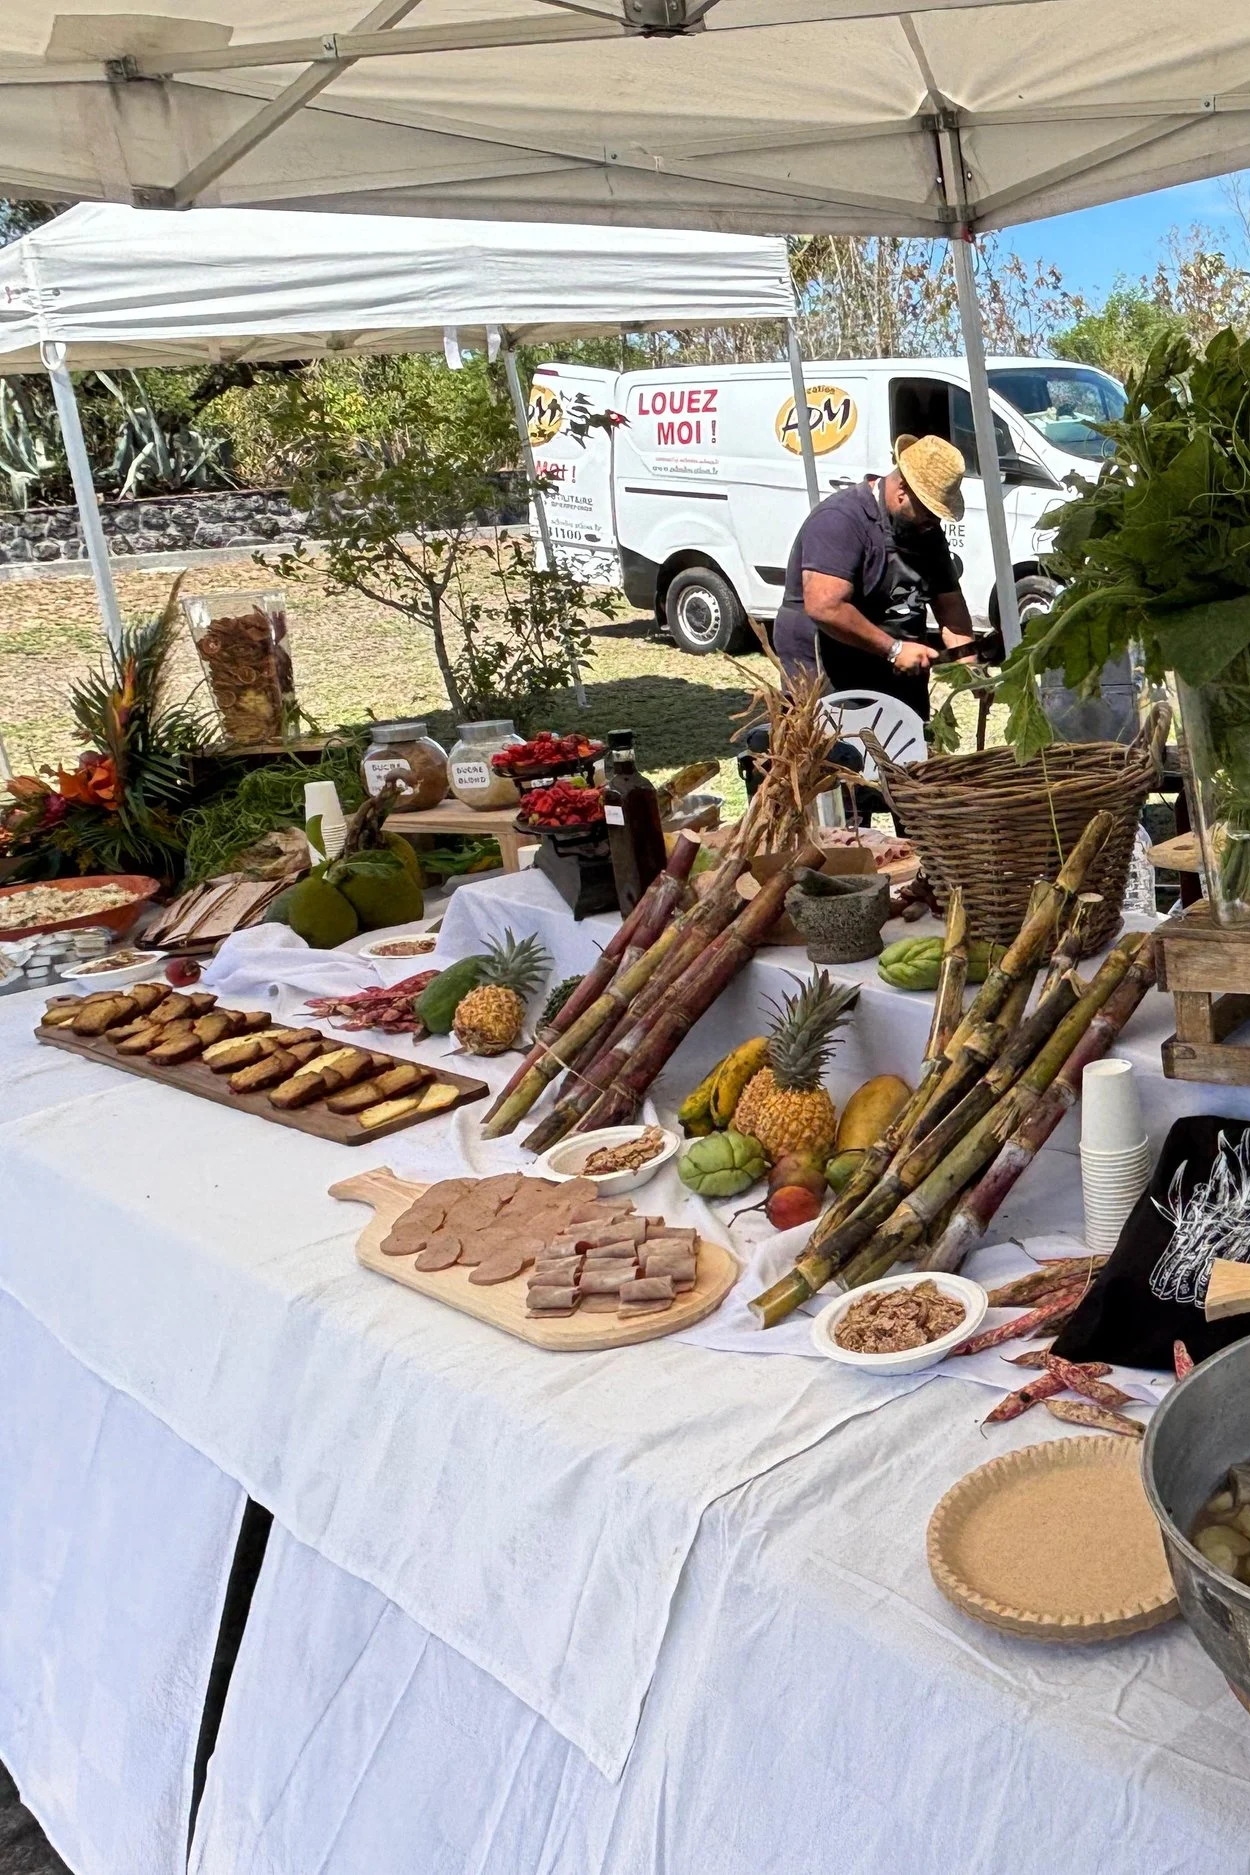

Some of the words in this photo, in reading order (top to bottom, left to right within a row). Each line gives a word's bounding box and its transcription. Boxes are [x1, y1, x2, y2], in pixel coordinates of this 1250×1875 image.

[638, 389, 718, 415] LOUEZ
[657, 420, 701, 445] MOI
[711, 420, 717, 443] !
